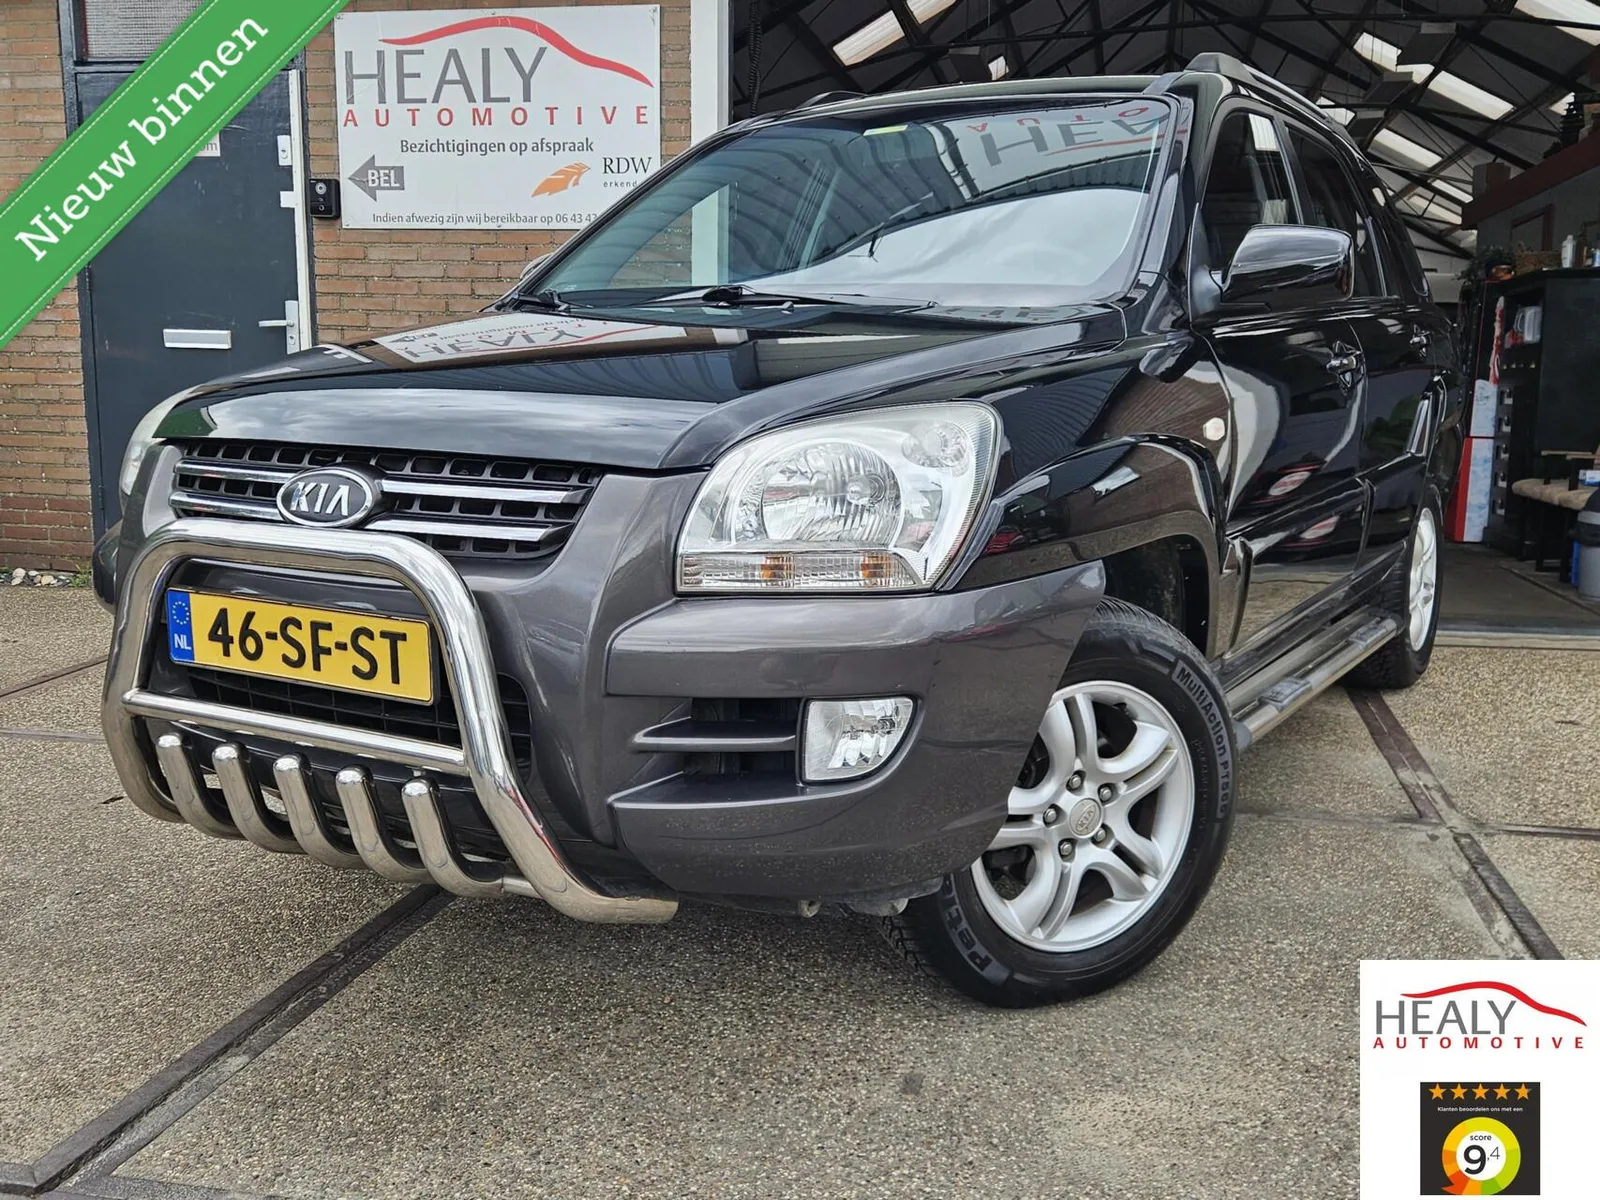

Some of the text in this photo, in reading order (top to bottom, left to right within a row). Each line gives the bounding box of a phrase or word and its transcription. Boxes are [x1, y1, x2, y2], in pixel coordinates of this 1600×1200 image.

[344, 47, 547, 105] HEALY
[343, 106, 648, 127] AUTOMOTIVE
[400, 137, 594, 156] Bezichtigingen op afspraak
[602, 157, 652, 174] RDW
[367, 169, 400, 188] BEL
[372, 213, 404, 223] Indien
[405, 213, 444, 226] afwezig
[446, 213, 464, 225] zijn
[466, 213, 482, 225] wij
[483, 212, 538, 224] bereikbaar
[540, 214, 553, 225] op
[555, 213, 568, 223] 06
[570, 213, 583, 223] 43
[290, 481, 350, 516] KIA
[174, 633, 192, 651] NL
[208, 608, 407, 685] 46-SF-ST
